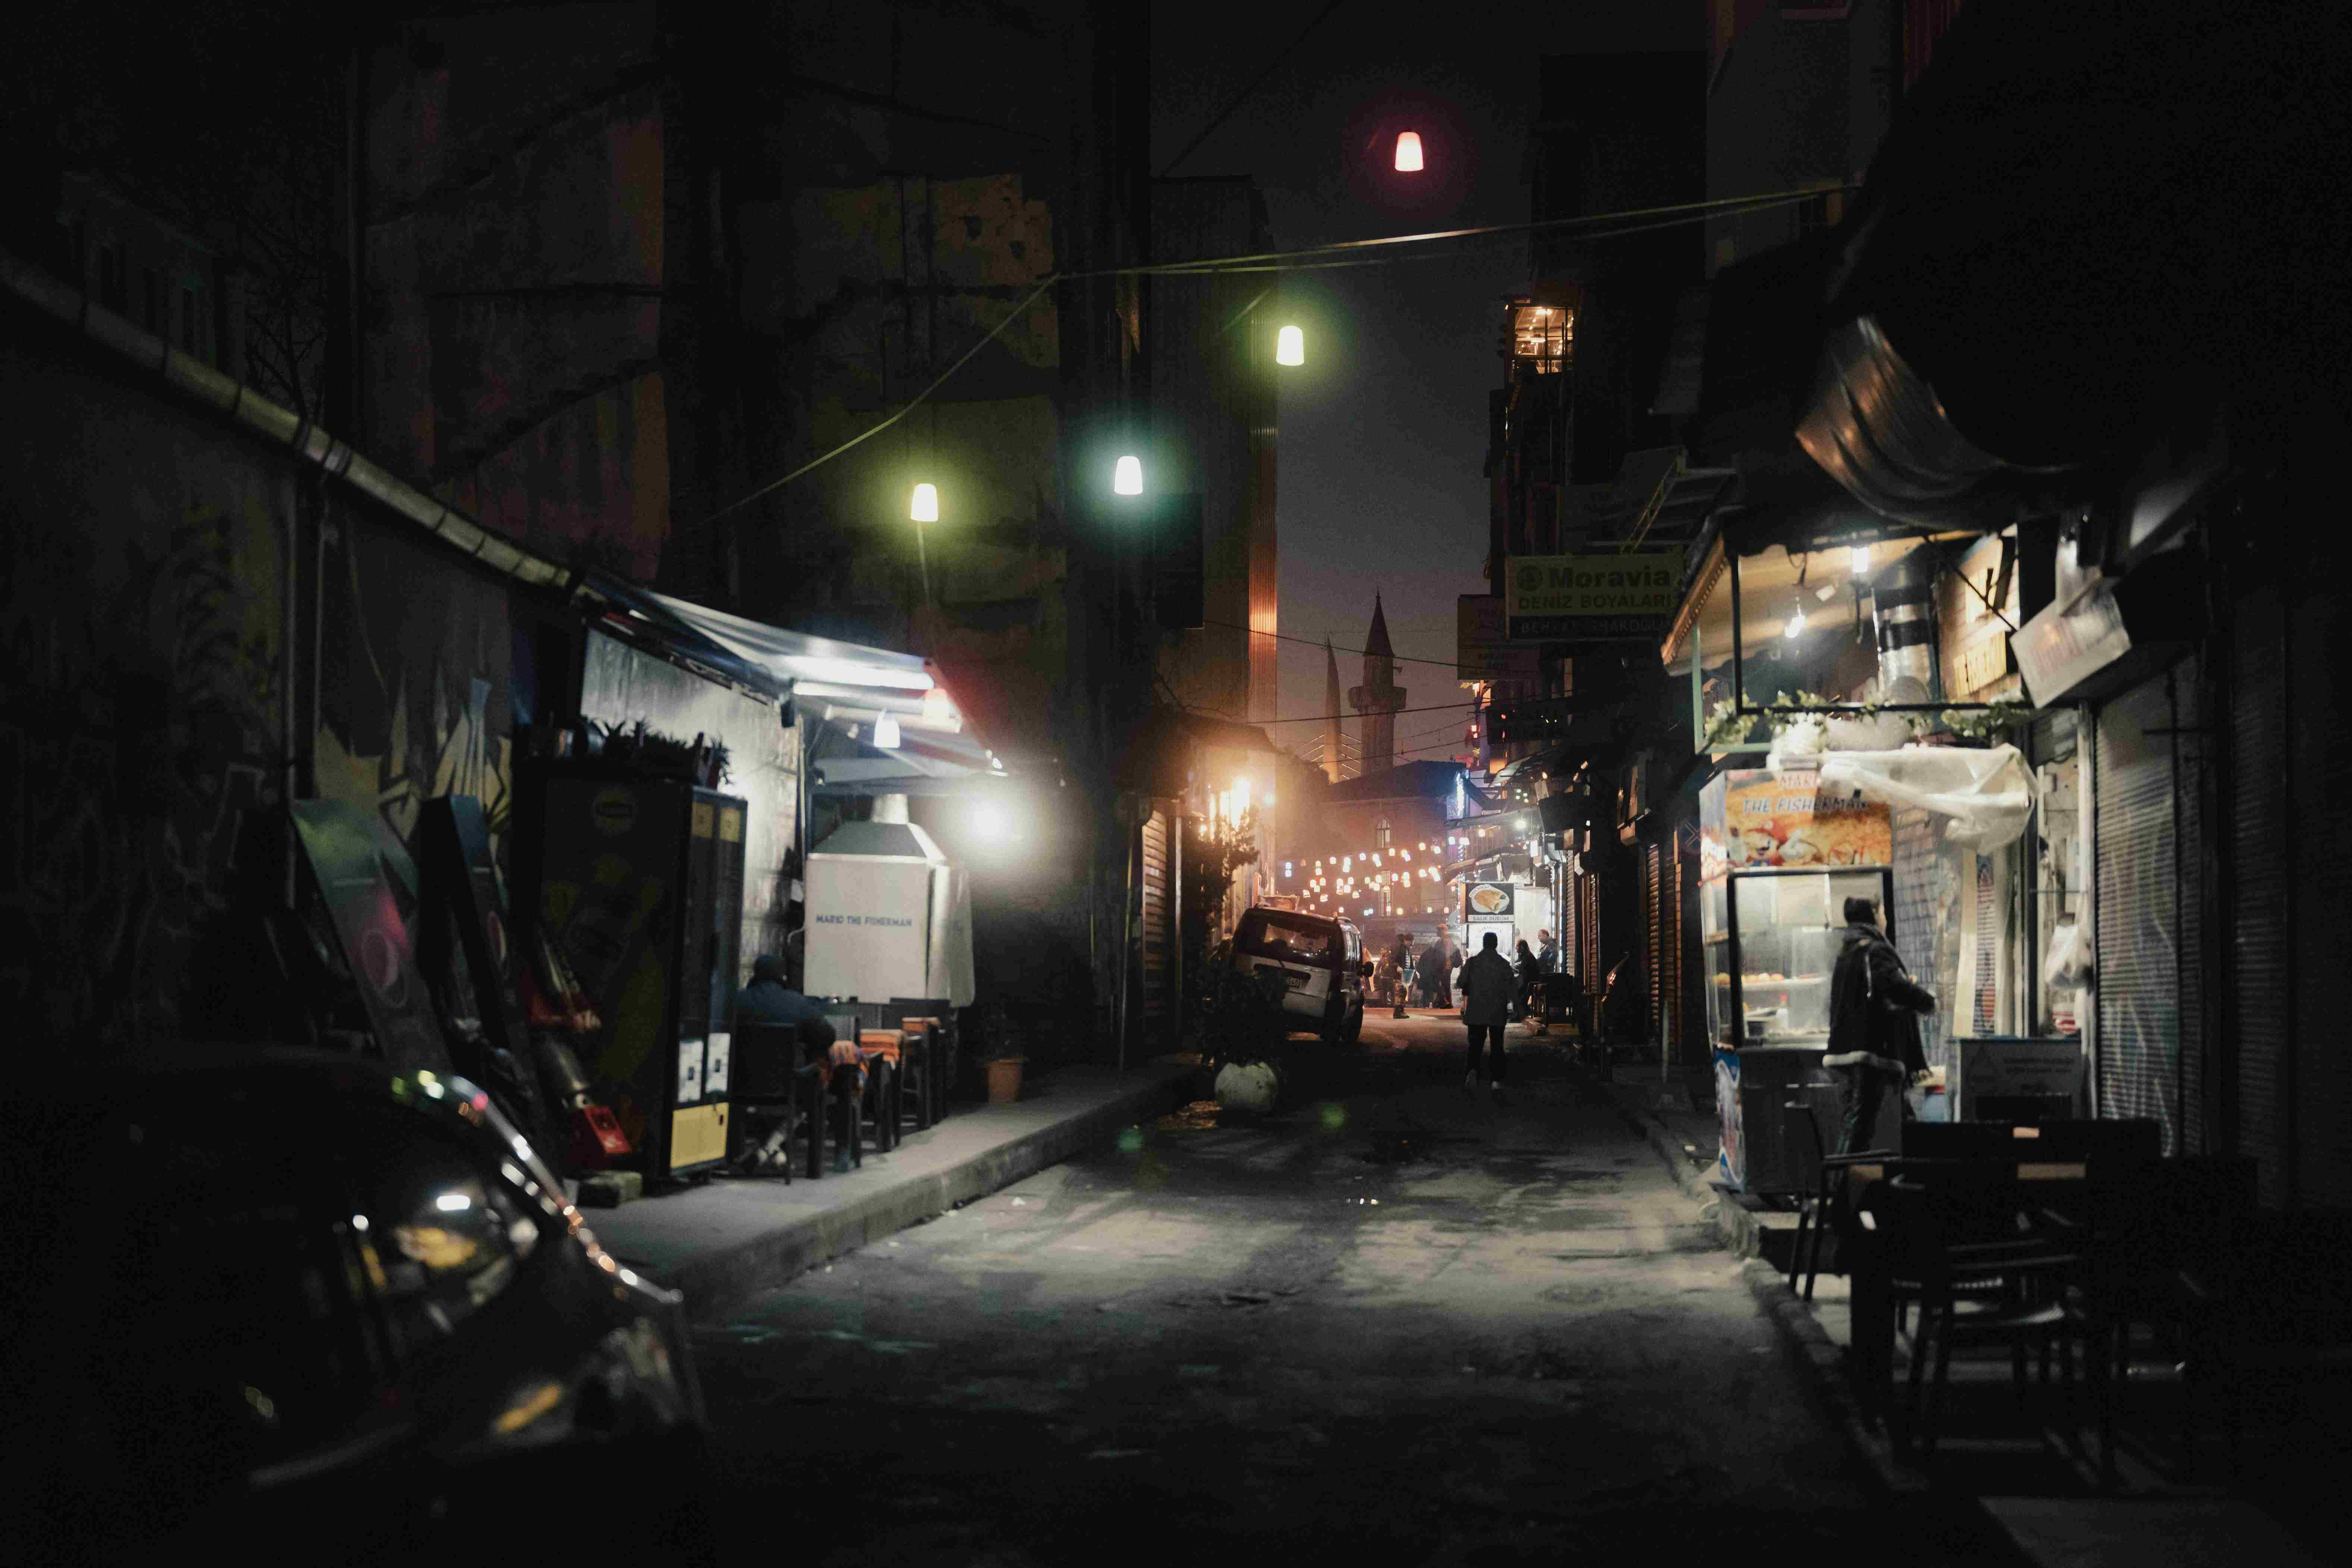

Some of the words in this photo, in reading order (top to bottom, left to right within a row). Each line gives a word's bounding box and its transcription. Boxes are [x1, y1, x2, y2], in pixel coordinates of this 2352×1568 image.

[1548, 565, 1670, 588] Moravia
[1581, 594, 1671, 609] BOYALARI
[1743, 799, 1770, 813] THE
[1777, 796, 1868, 812] FISHERMAN
[816, 914, 844, 924] MARIO
[847, 915, 861, 925] THE
[865, 917, 912, 926] FISHERMAN
